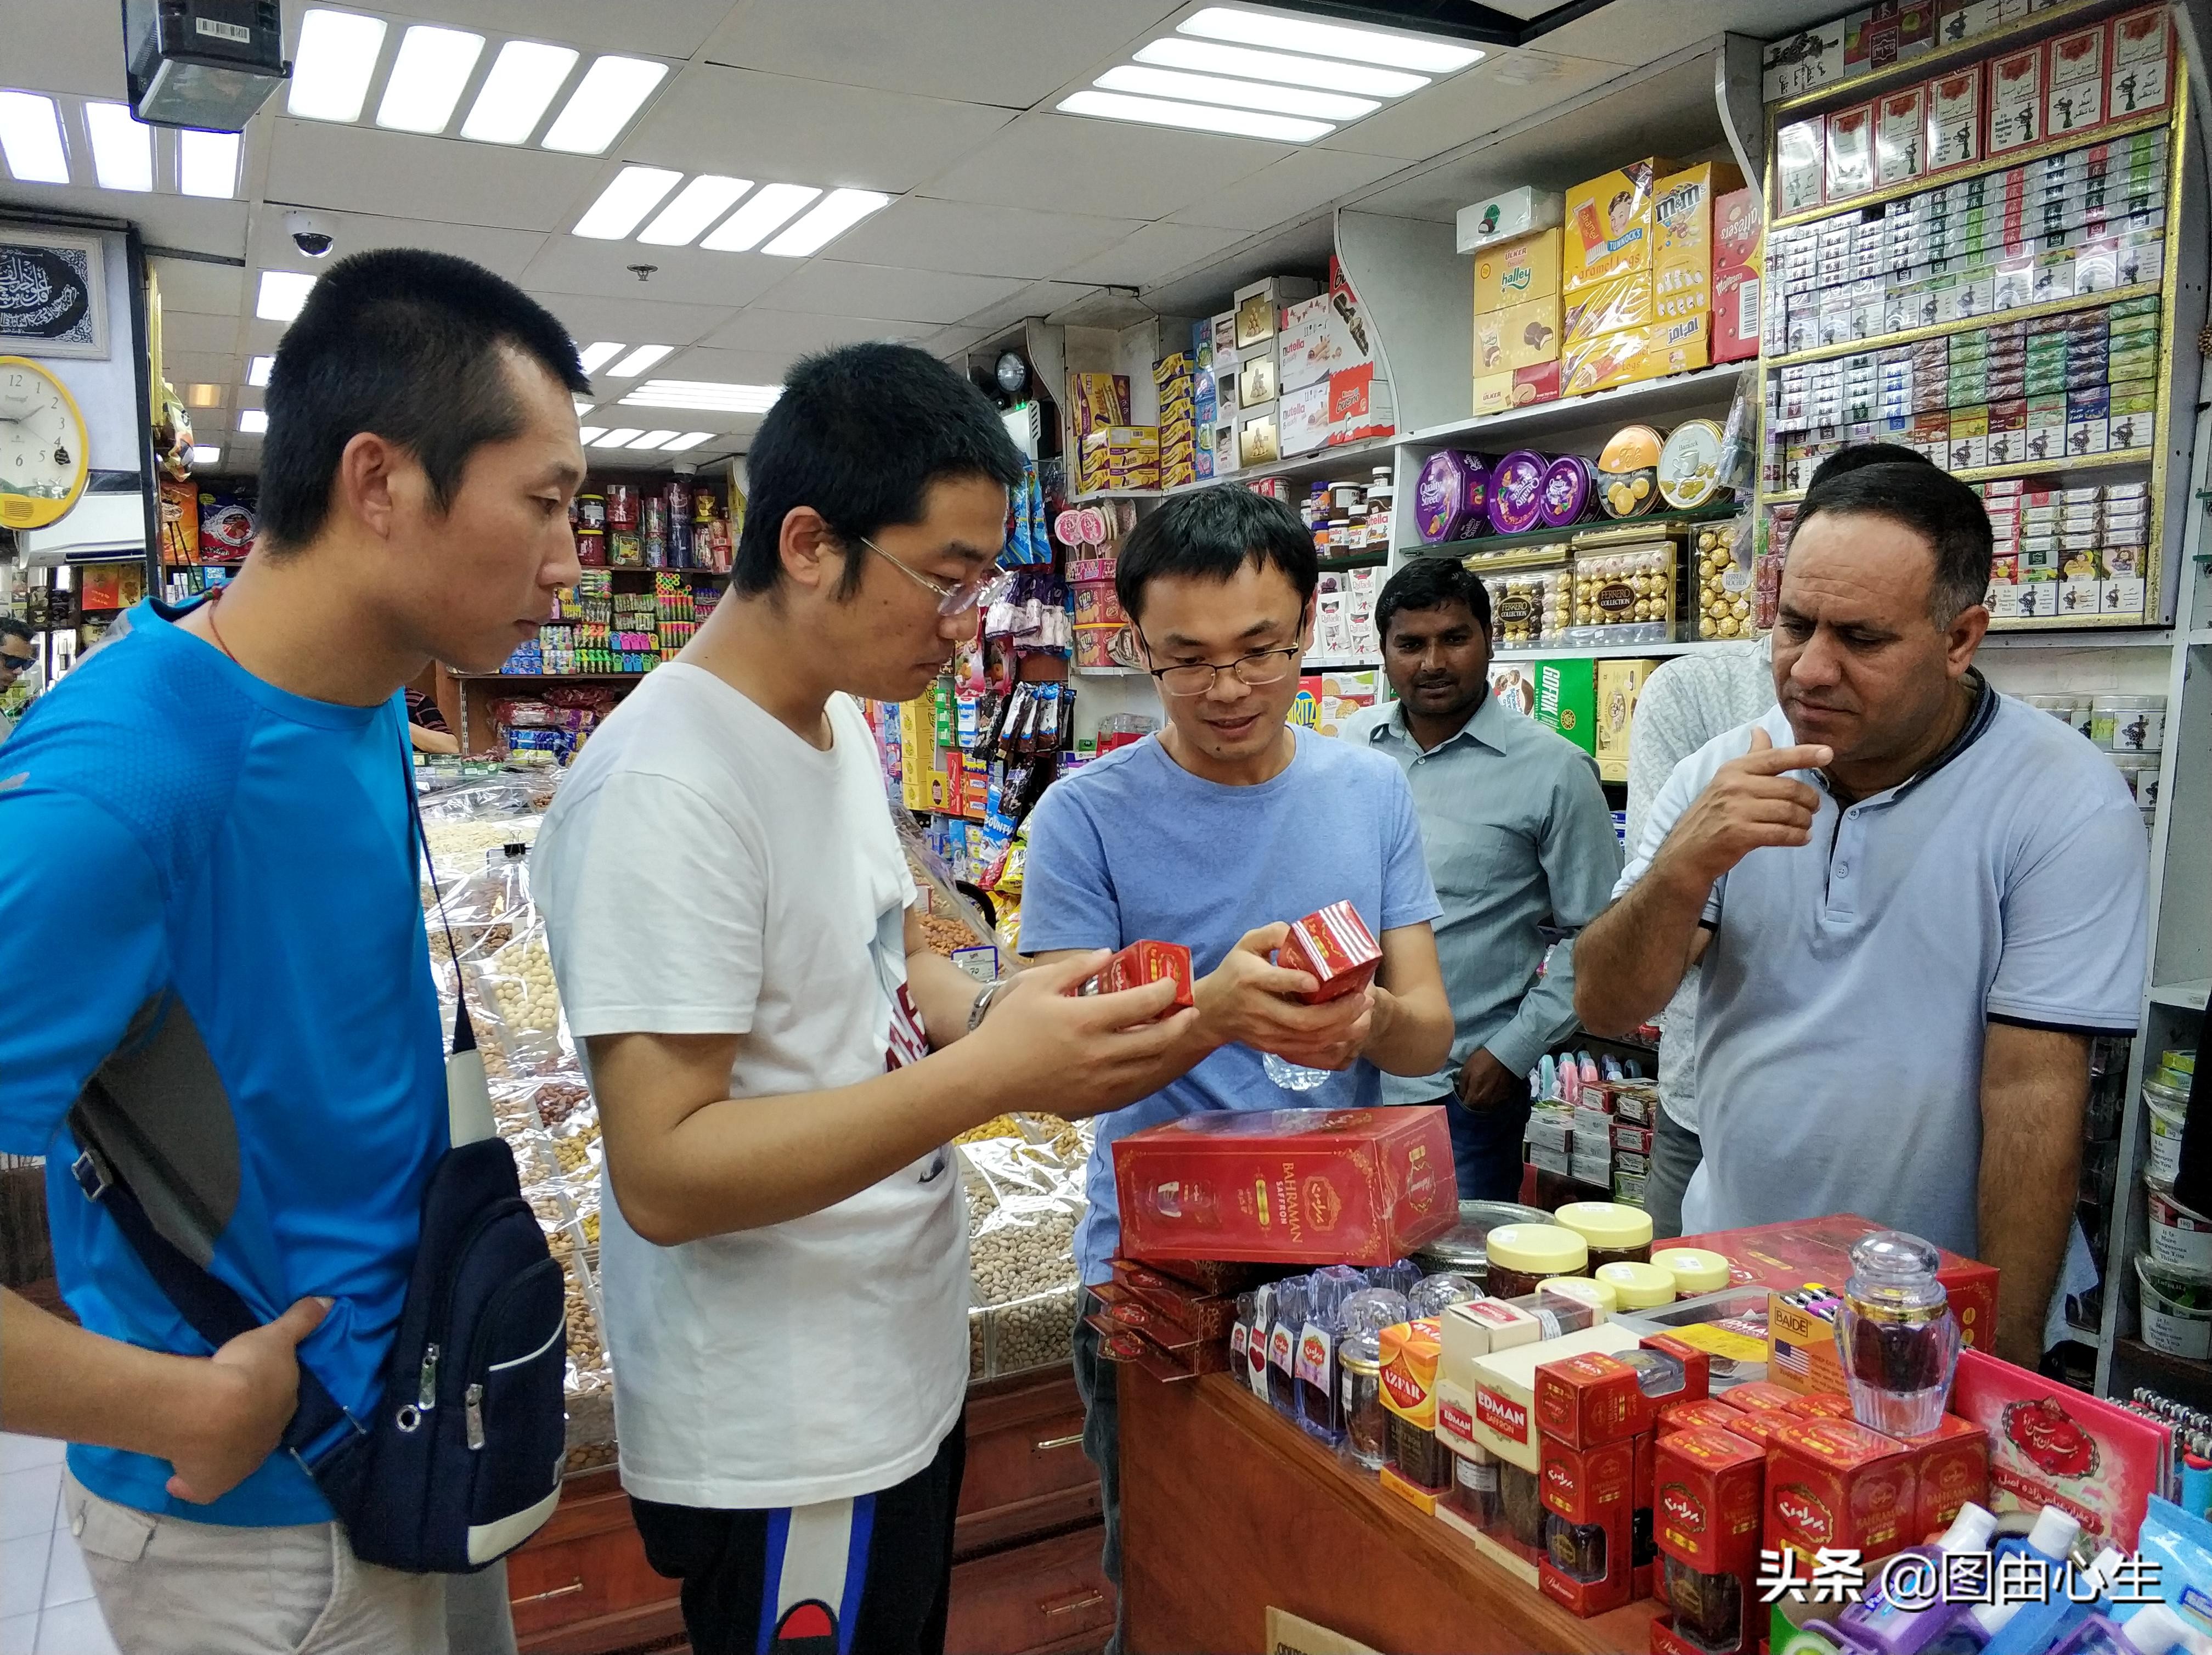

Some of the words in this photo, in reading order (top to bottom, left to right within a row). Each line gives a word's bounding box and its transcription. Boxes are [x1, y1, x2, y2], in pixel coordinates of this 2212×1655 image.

[1720, 207, 1761, 240] altesers
[1610, 229, 1640, 251] TUNNOCK'S
[1505, 246, 1527, 260] ÜLKER
[1501, 267, 1532, 290] halley
[1716, 272, 1742, 297] Maltesers
[1283, 339, 1305, 356] nutella
[9, 374, 22, 386] 12
[36, 382, 41, 393] 1
[51, 397, 59, 409] 2
[1336, 393, 1359, 413] bueno
[1483, 391, 1501, 401] ÜLKER
[1283, 403, 1305, 420] nutella
[59, 418, 65, 429] 3
[54, 436, 61, 448] 4
[15, 454, 23, 466] 6
[38, 450, 46, 462] 5
[1420, 481, 1442, 497] Quality
[1549, 479, 1567, 489] Quality
[1421, 494, 1440, 507] Street
[1516, 477, 1539, 509] Quality
[1353, 581, 1374, 590] Raffaello
[1601, 589, 1630, 599] FERRERO
[1502, 602, 1527, 611] FERRERO
[1601, 598, 1630, 607] COLLECTION
[1294, 699, 1316, 727] RITZ
[984, 814, 1014, 836] BOUNTY
[1276, 1181, 1288, 1224] SAFFRON
[1282, 1162, 1303, 1243] BAHRAMAN
[2161, 1234, 2176, 1244] More
[1776, 1310, 1806, 1332] BAIDE
[1478, 1391, 1524, 1427] EDMAN
[1444, 1409, 1471, 1432] EDMAN
